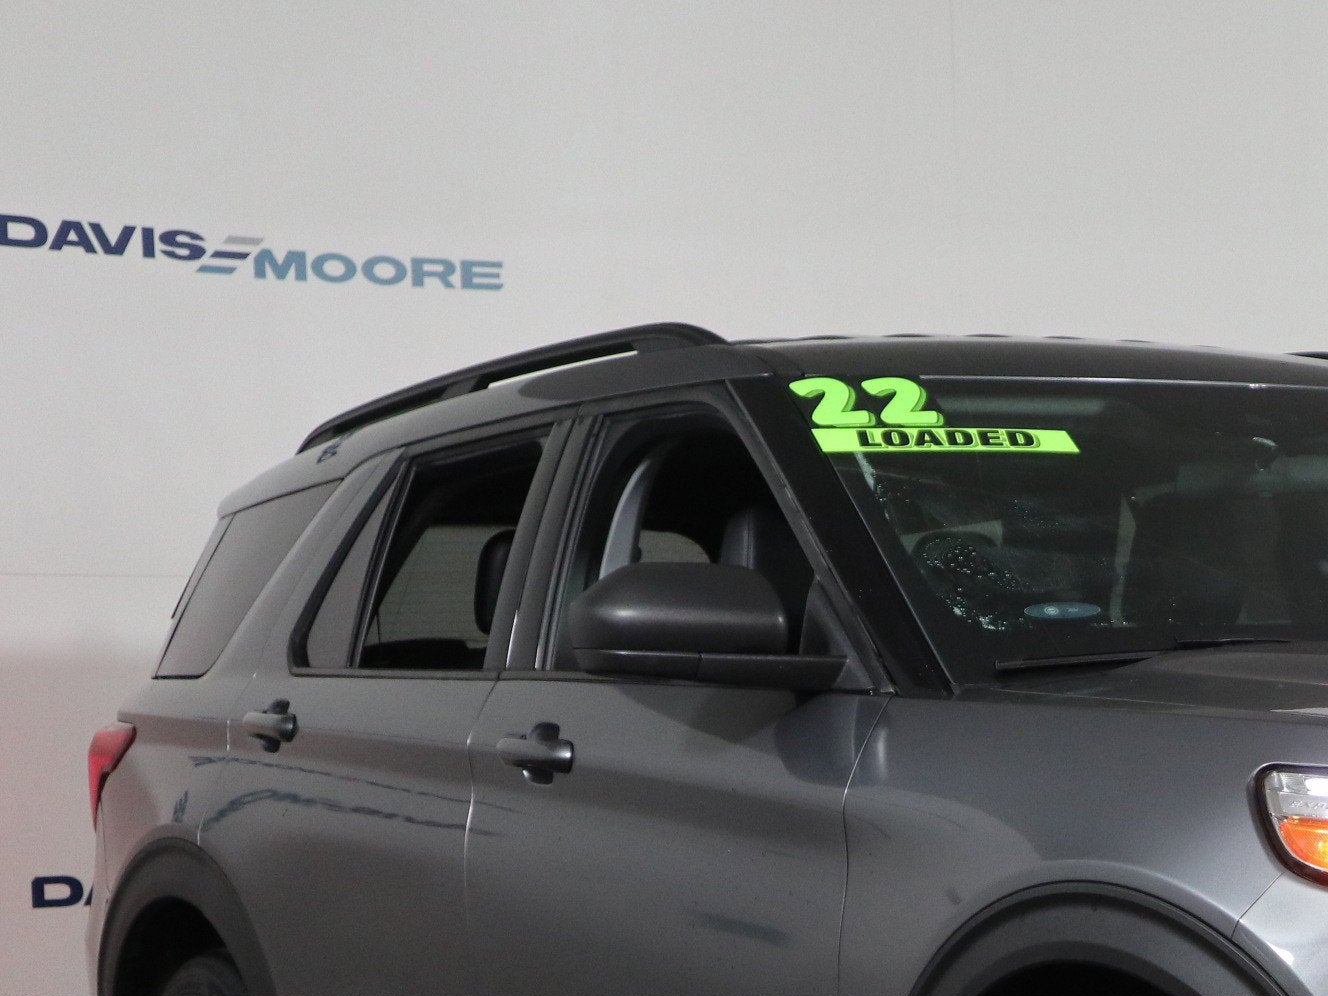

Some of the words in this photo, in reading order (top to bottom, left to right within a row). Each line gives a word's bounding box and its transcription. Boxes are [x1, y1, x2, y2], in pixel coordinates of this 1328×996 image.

[0, 213, 206, 262] DAVIS
[253, 248, 504, 291] MOORE
[788, 376, 944, 427] 22
[856, 429, 1040, 450] LOADED
